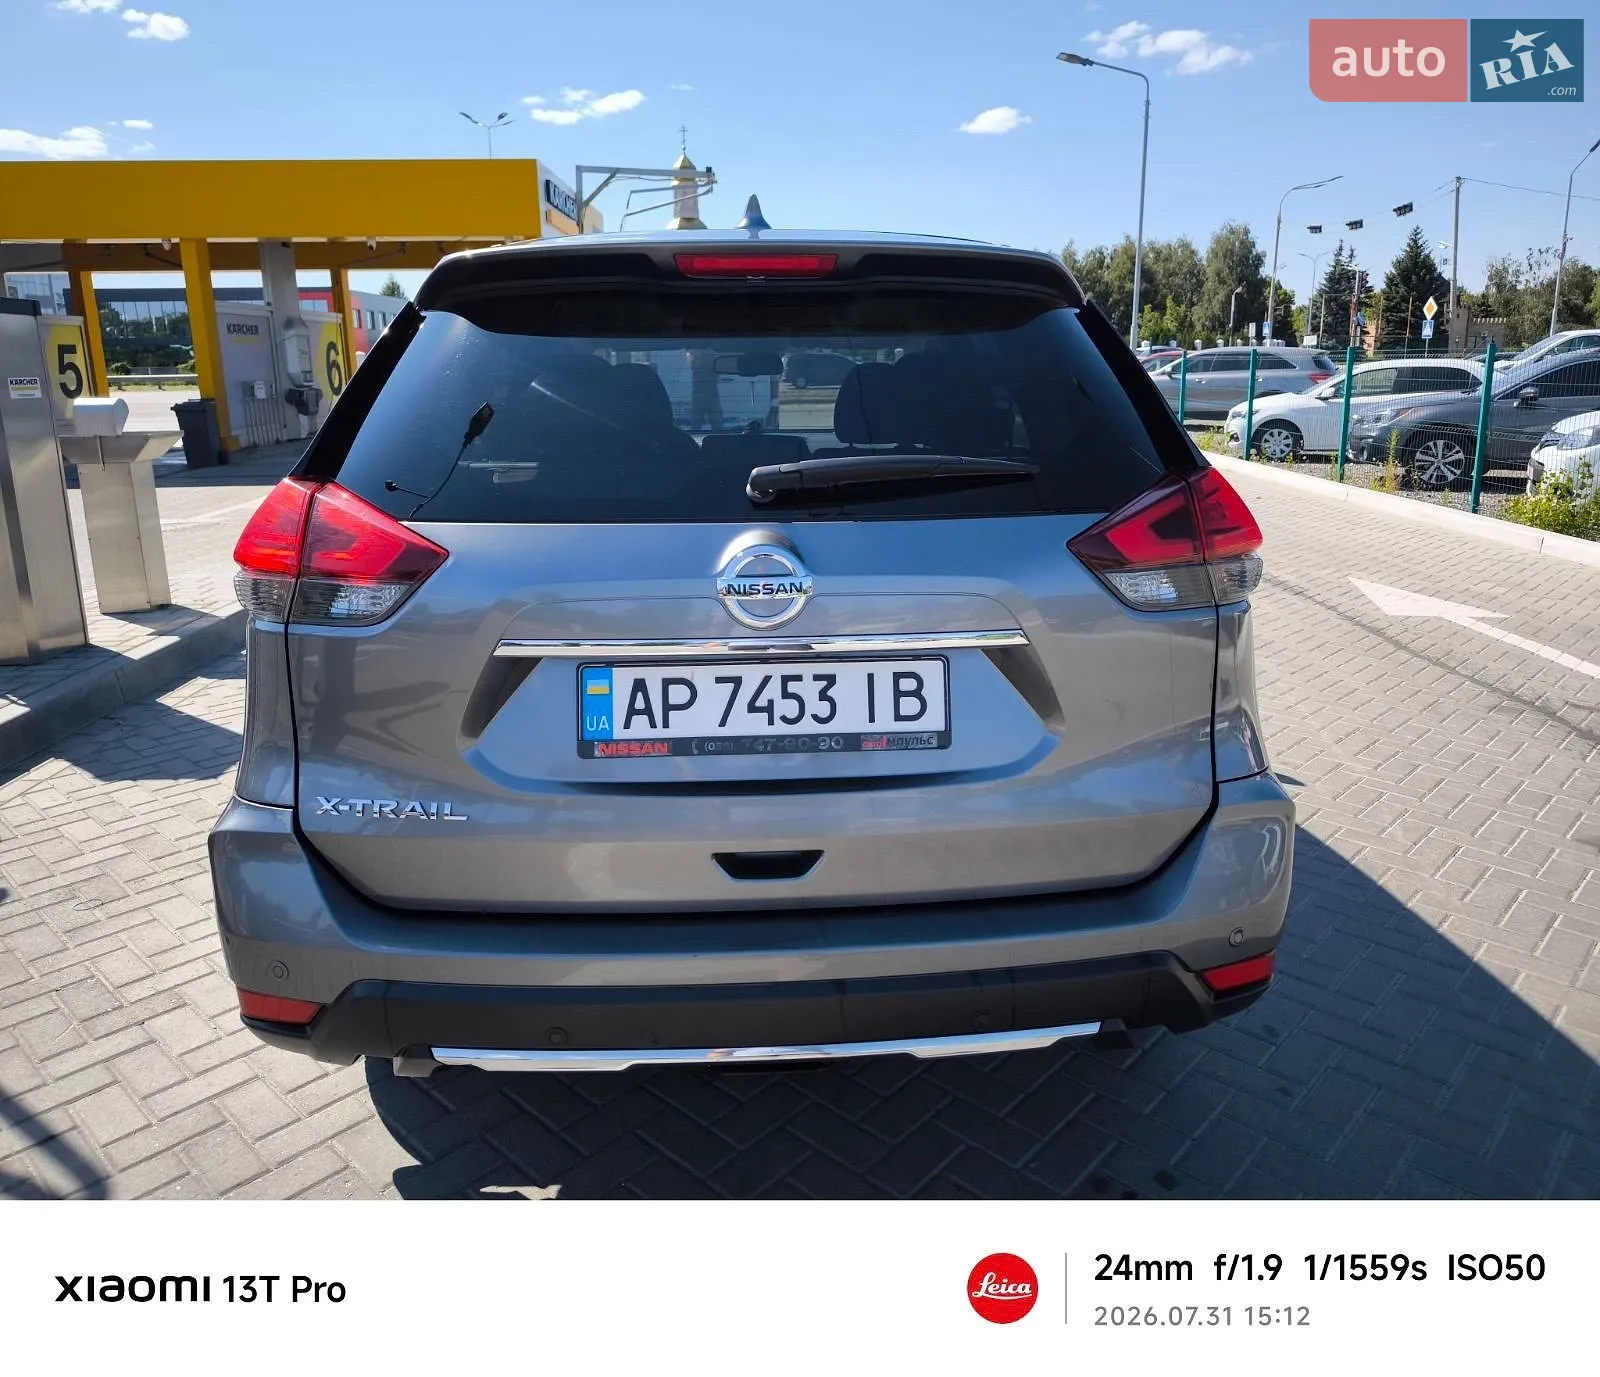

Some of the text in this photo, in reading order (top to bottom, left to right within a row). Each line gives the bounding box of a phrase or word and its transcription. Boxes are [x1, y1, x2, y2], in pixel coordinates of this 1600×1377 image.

[57, 343, 83, 399] 5
[326, 340, 343, 396] 6
[726, 581, 804, 596] NISSAN
[623, 671, 928, 730] AP 7453 IB
[586, 715, 610, 731] UA
[597, 741, 669, 756] NISSAN
[316, 796, 469, 821] X-TRAIL
